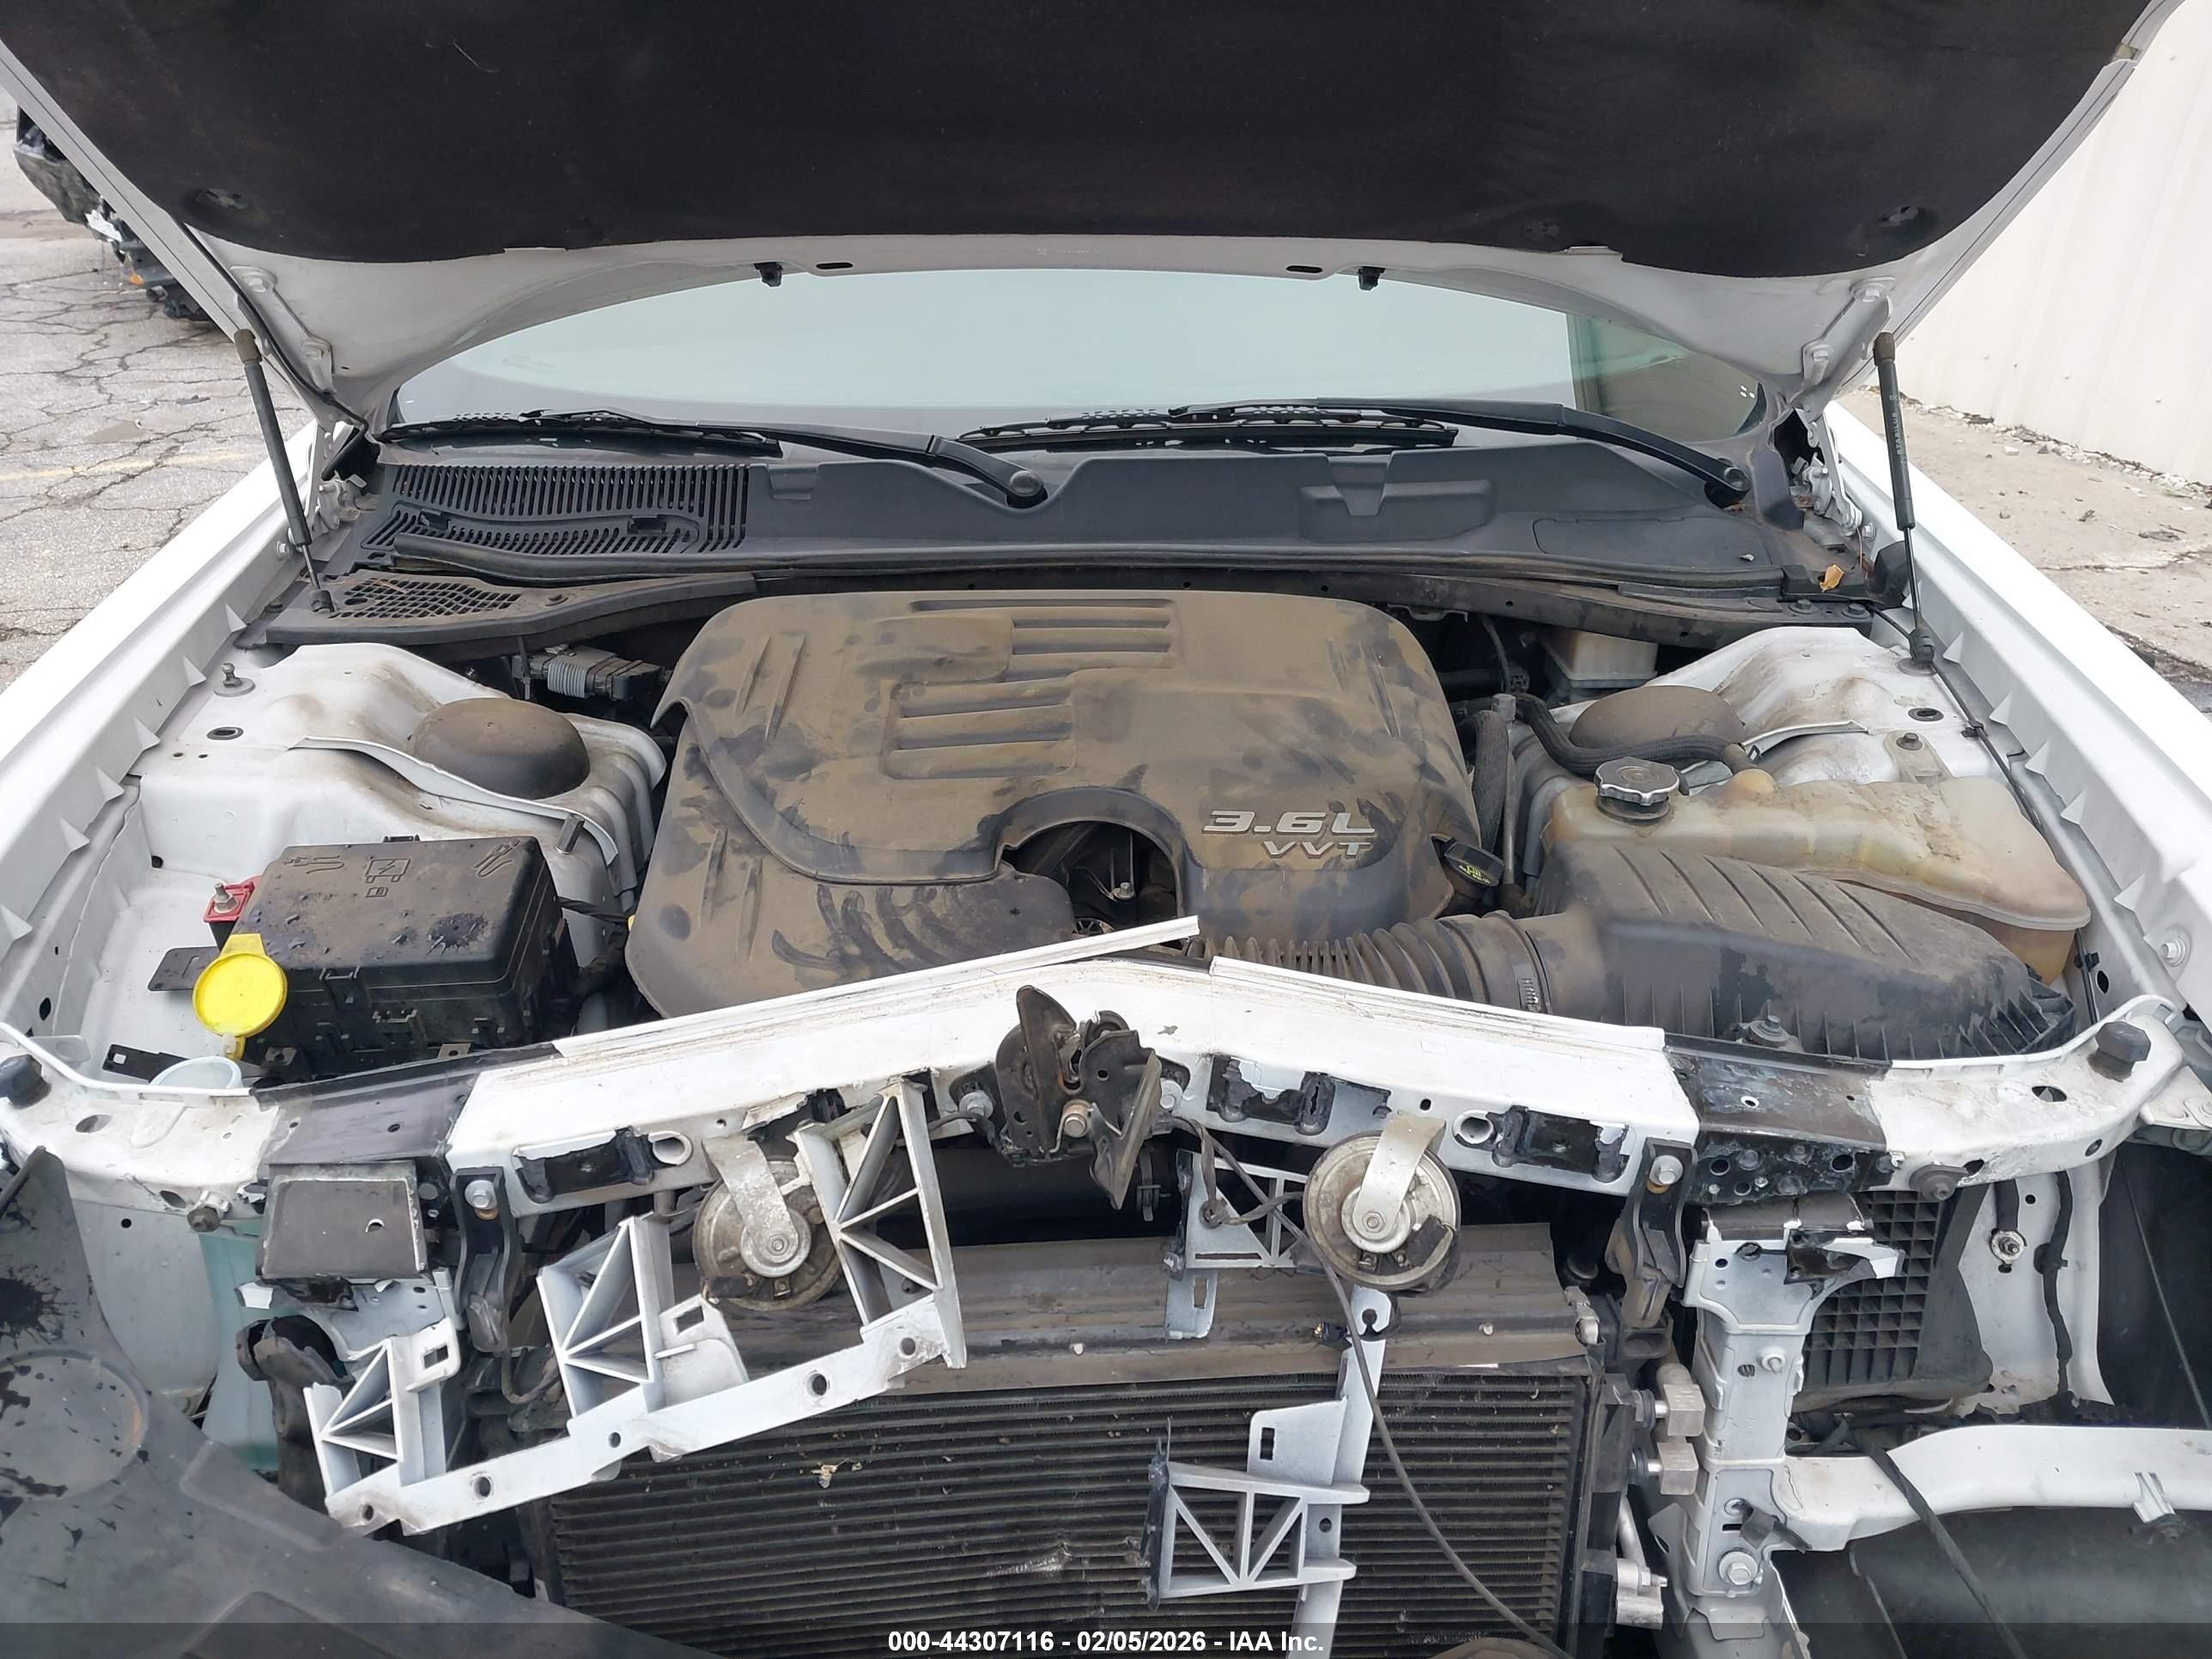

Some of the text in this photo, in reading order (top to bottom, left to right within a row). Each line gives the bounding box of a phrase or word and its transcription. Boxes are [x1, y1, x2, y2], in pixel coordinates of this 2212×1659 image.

[1892, 412, 1902, 455] STABILUS
[1202, 811, 1376, 834] 3.6L
[1262, 841, 1371, 858] VVT
